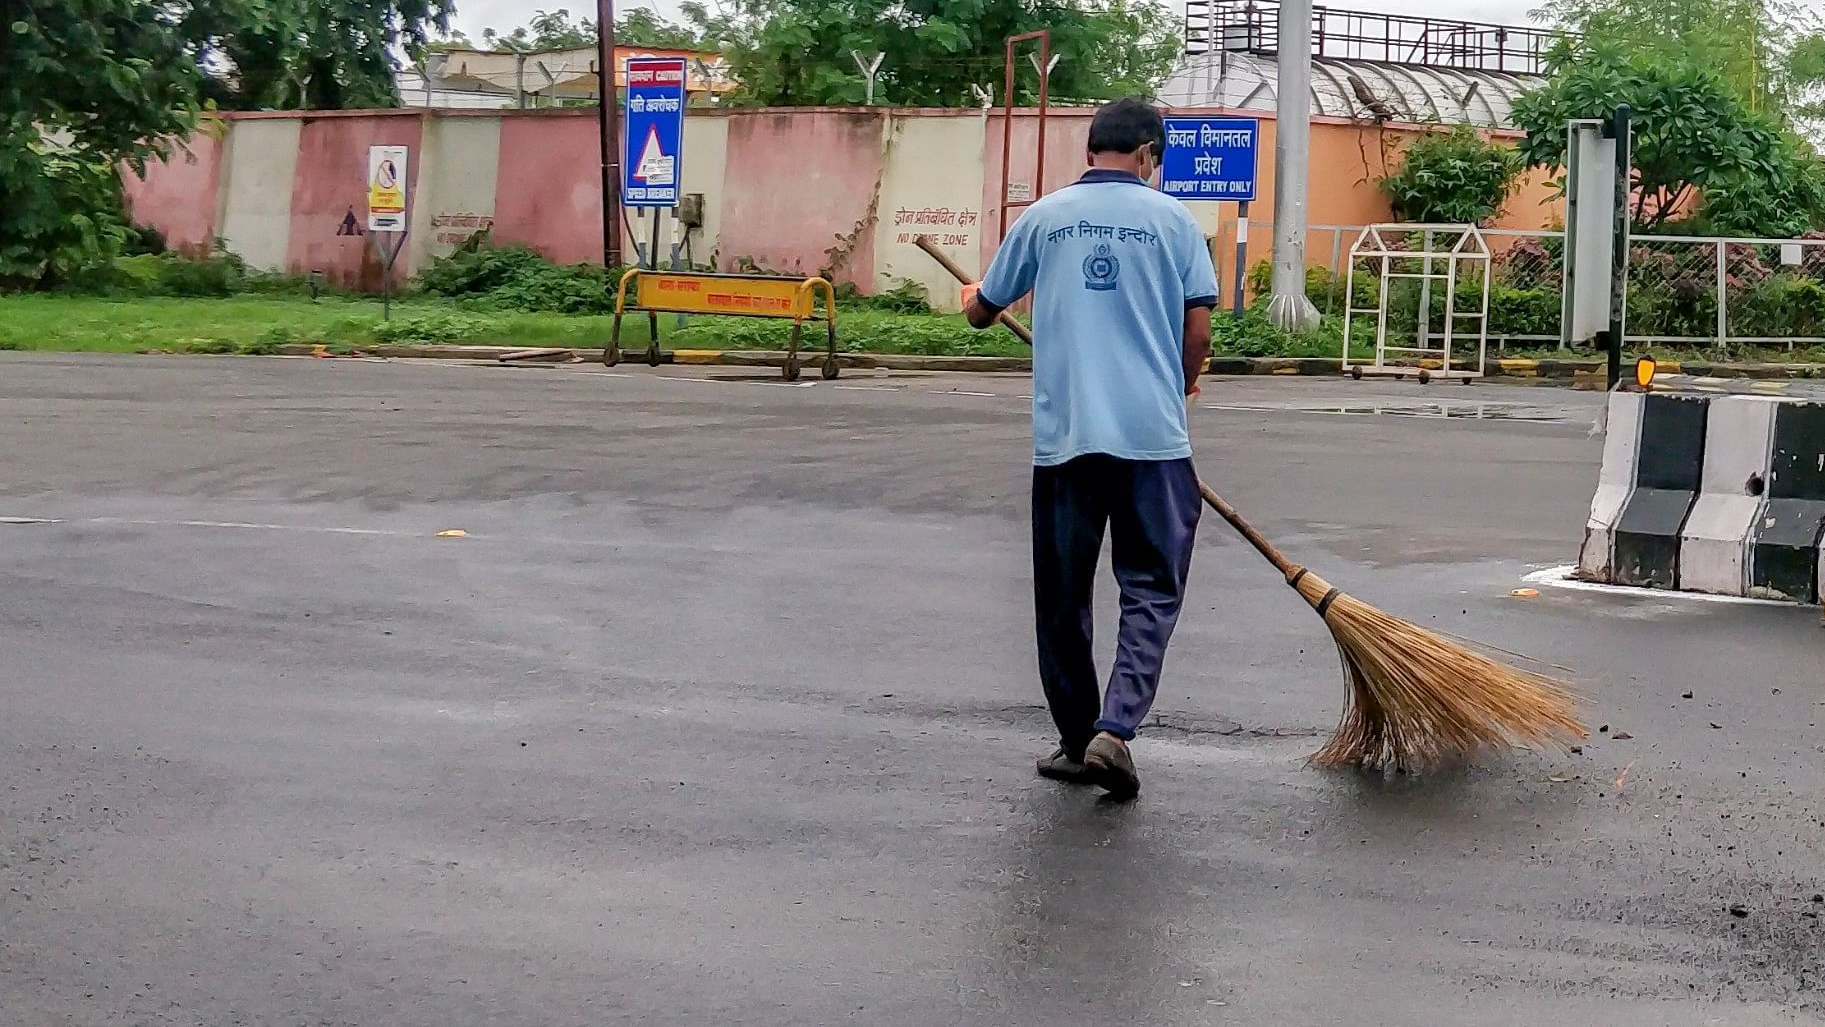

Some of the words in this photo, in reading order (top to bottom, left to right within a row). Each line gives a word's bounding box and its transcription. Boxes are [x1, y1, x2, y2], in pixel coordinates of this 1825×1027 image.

[1168, 124, 1196, 148] केवल
[1200, 123, 1252, 148] विमानतल
[1194, 151, 1222, 175] प्रवेश
[1164, 180, 1199, 192] AIRPORT
[1200, 180, 1227, 192] ENTRY
[1229, 180, 1251, 192] ONLY
[897, 233, 909, 244] NO
[942, 234, 968, 245] ZONE
[1047, 225, 1074, 243] नगर
[1079, 220, 1115, 239] निगम
